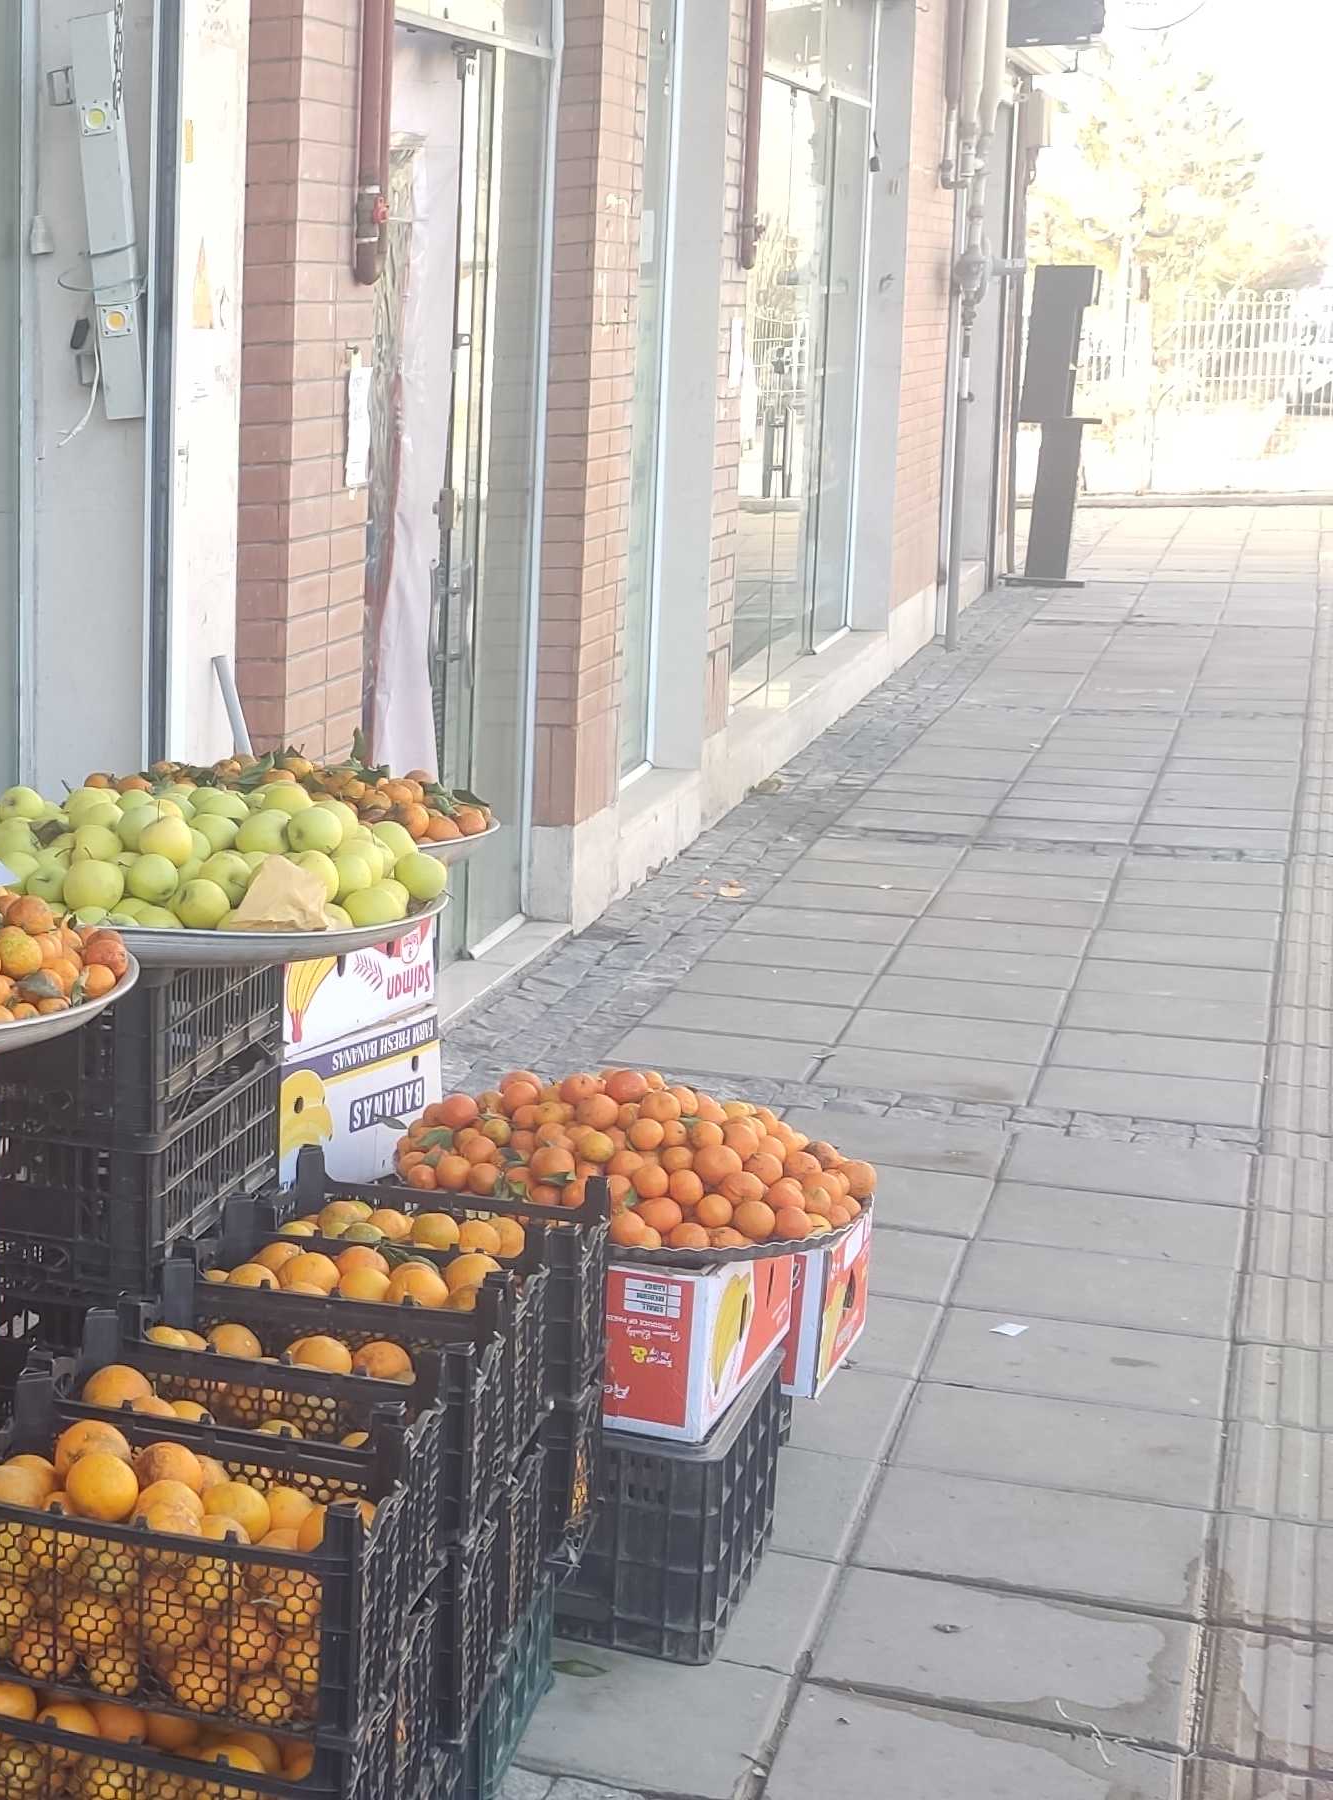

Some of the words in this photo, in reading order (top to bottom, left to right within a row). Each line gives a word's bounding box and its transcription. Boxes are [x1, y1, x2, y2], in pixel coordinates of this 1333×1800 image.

[387, 960, 430, 1000] Salman
[381, 1029, 410, 1054] FRESH
[413, 1020, 433, 1044] FARM
[333, 1040, 377, 1070] BANANAS
[353, 1081, 422, 1129] BANANAS
